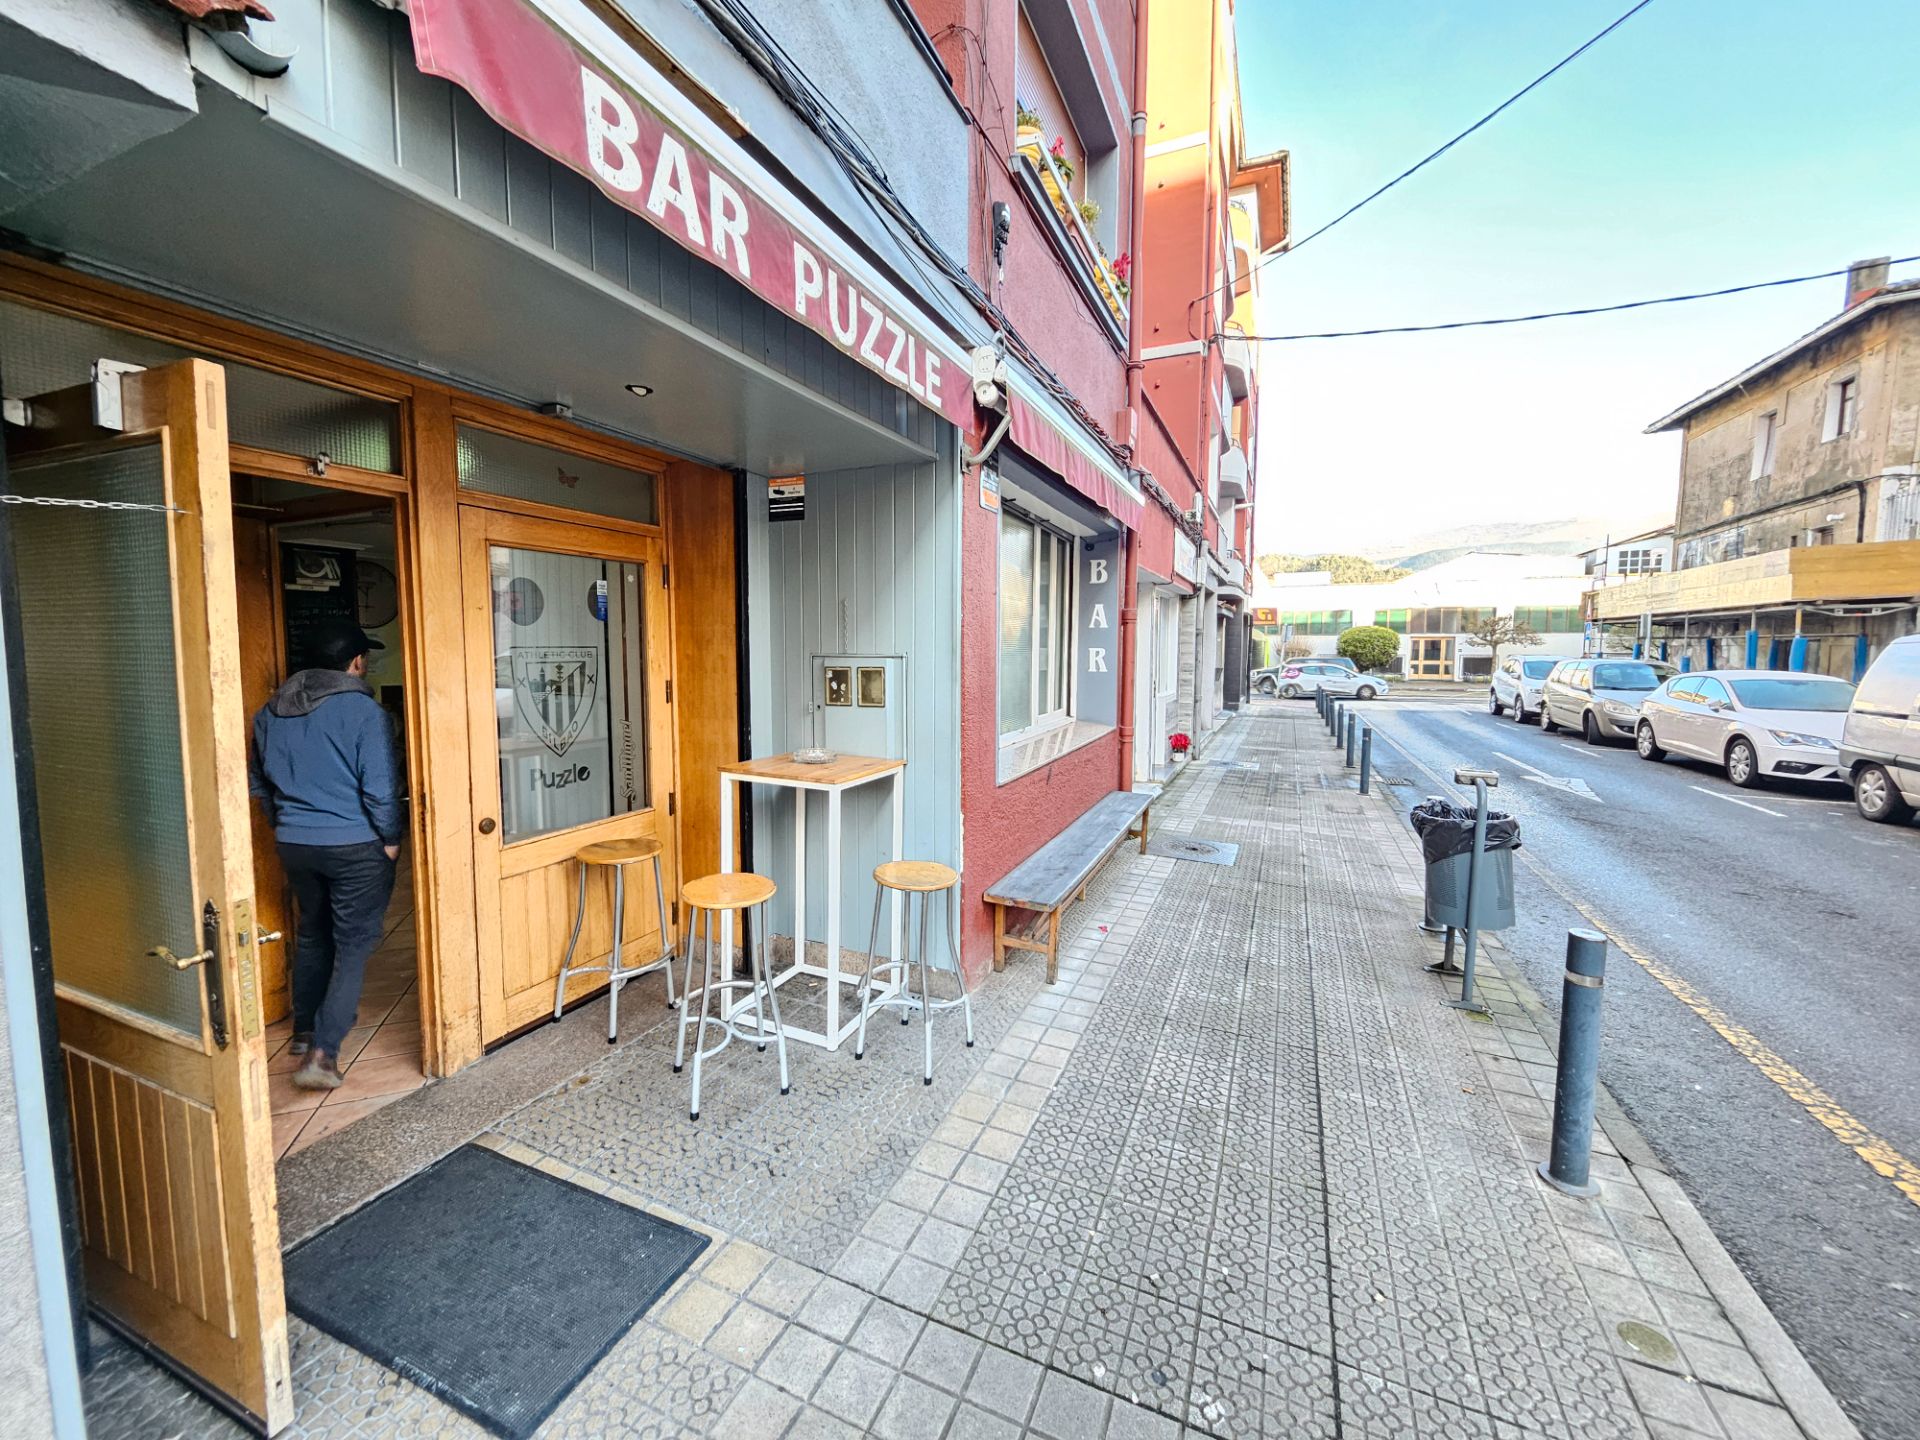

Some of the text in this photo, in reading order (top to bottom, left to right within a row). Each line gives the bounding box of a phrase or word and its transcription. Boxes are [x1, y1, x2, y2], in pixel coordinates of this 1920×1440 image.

[580, 65, 943, 409] BAR PUZZLE
[1088, 559, 1108, 673] BAR
[568, 651, 593, 659] CLUB
[542, 720, 578, 751] BILBAO
[529, 763, 591, 791] Puzzle
